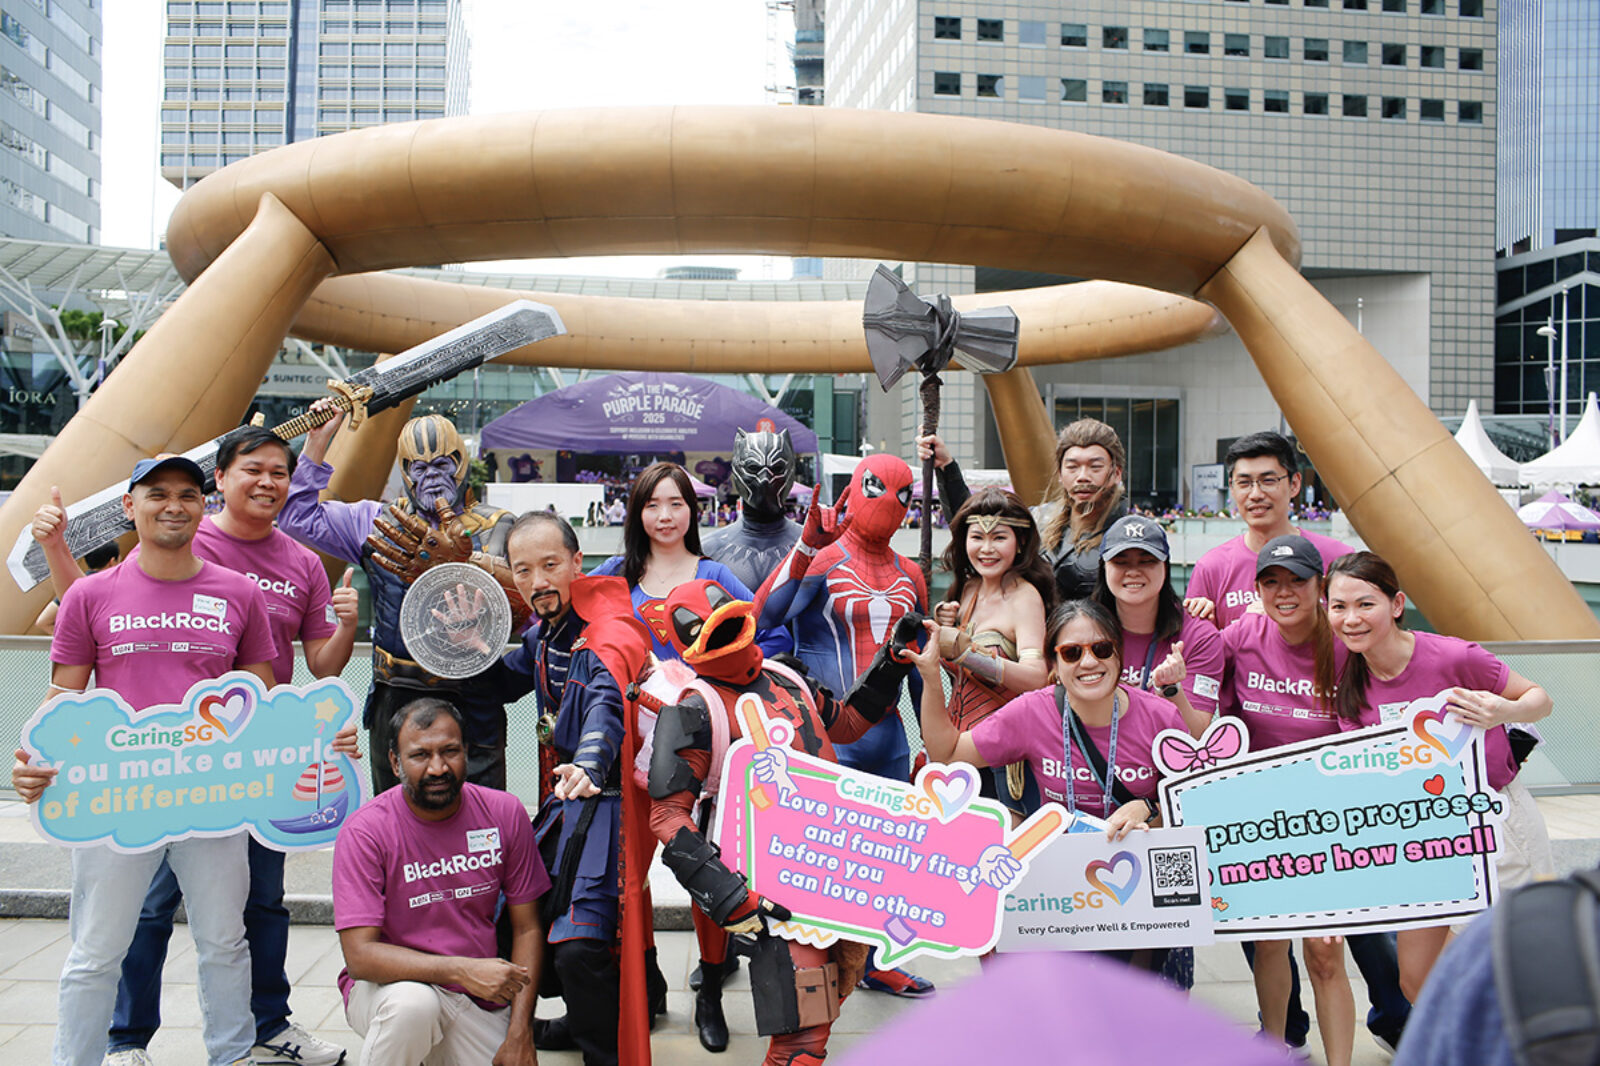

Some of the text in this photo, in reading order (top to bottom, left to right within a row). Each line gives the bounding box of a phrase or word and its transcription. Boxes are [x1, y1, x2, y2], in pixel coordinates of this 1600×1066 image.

[273, 374, 312, 384] SUNTEC
[646, 384, 661, 394] THE
[602, 395, 704, 420] PURPLE PARADE
[642, 412, 666, 424] 2025
[1124, 522, 1145, 538] NY
[110, 612, 231, 635] BlackRock
[111, 724, 213, 748] CaringSG
[119, 747, 213, 780] make
[222, 751, 243, 770] a
[1320, 744, 1434, 771] CaringSG
[44, 773, 275, 820] of difference!
[840, 777, 931, 816] CaringSG
[778, 788, 928, 844] Love yourself
[1205, 792, 1503, 853] preciate progress,
[403, 849, 503, 883] BlackRock
[768, 835, 885, 885] before you
[804, 824, 981, 884] and family first
[1219, 852, 1326, 885] matter
[1331, 844, 1397, 877] how
[1403, 825, 1497, 863] small
[778, 868, 946, 929] can love others
[1004, 891, 1104, 914] CaringSG
[1018, 919, 1190, 936] Every Caregiver Well & Empowered
